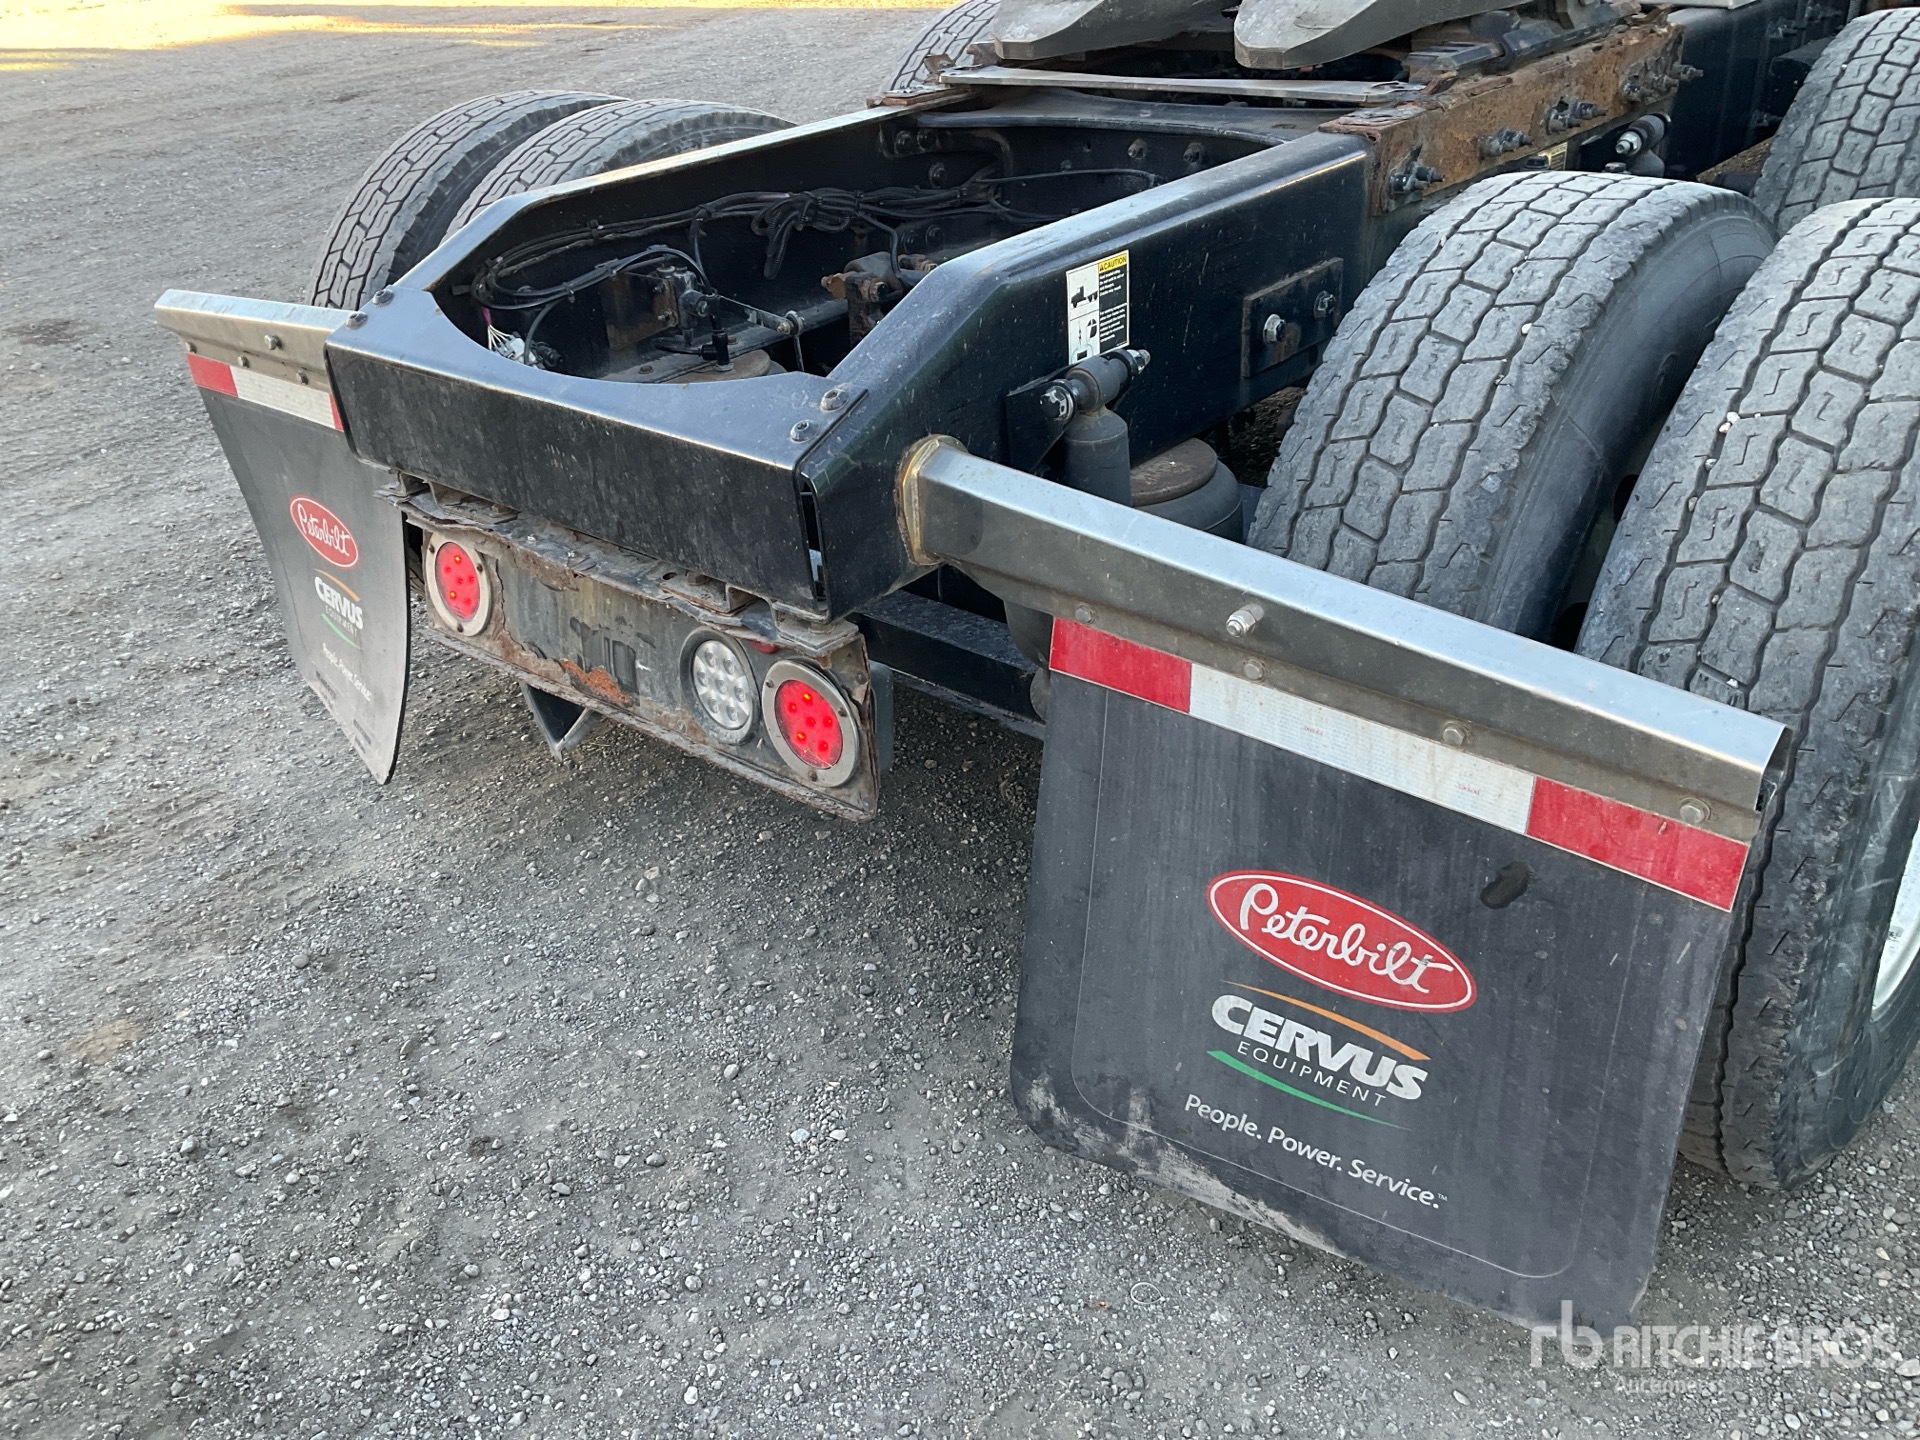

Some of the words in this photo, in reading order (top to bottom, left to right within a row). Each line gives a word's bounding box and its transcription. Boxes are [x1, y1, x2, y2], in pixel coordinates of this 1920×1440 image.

[1103, 257, 1127, 270] CAUTION
[297, 503, 350, 556] Peterbilt
[314, 576, 363, 630] CERVUS
[1239, 883, 1453, 994] Peterbilt
[1211, 994, 1428, 1100] CERVUS
[1237, 1041, 1386, 1107] EQUIPMENT
[1184, 1093, 1262, 1140] People.
[1267, 1126, 1342, 1172] Power.
